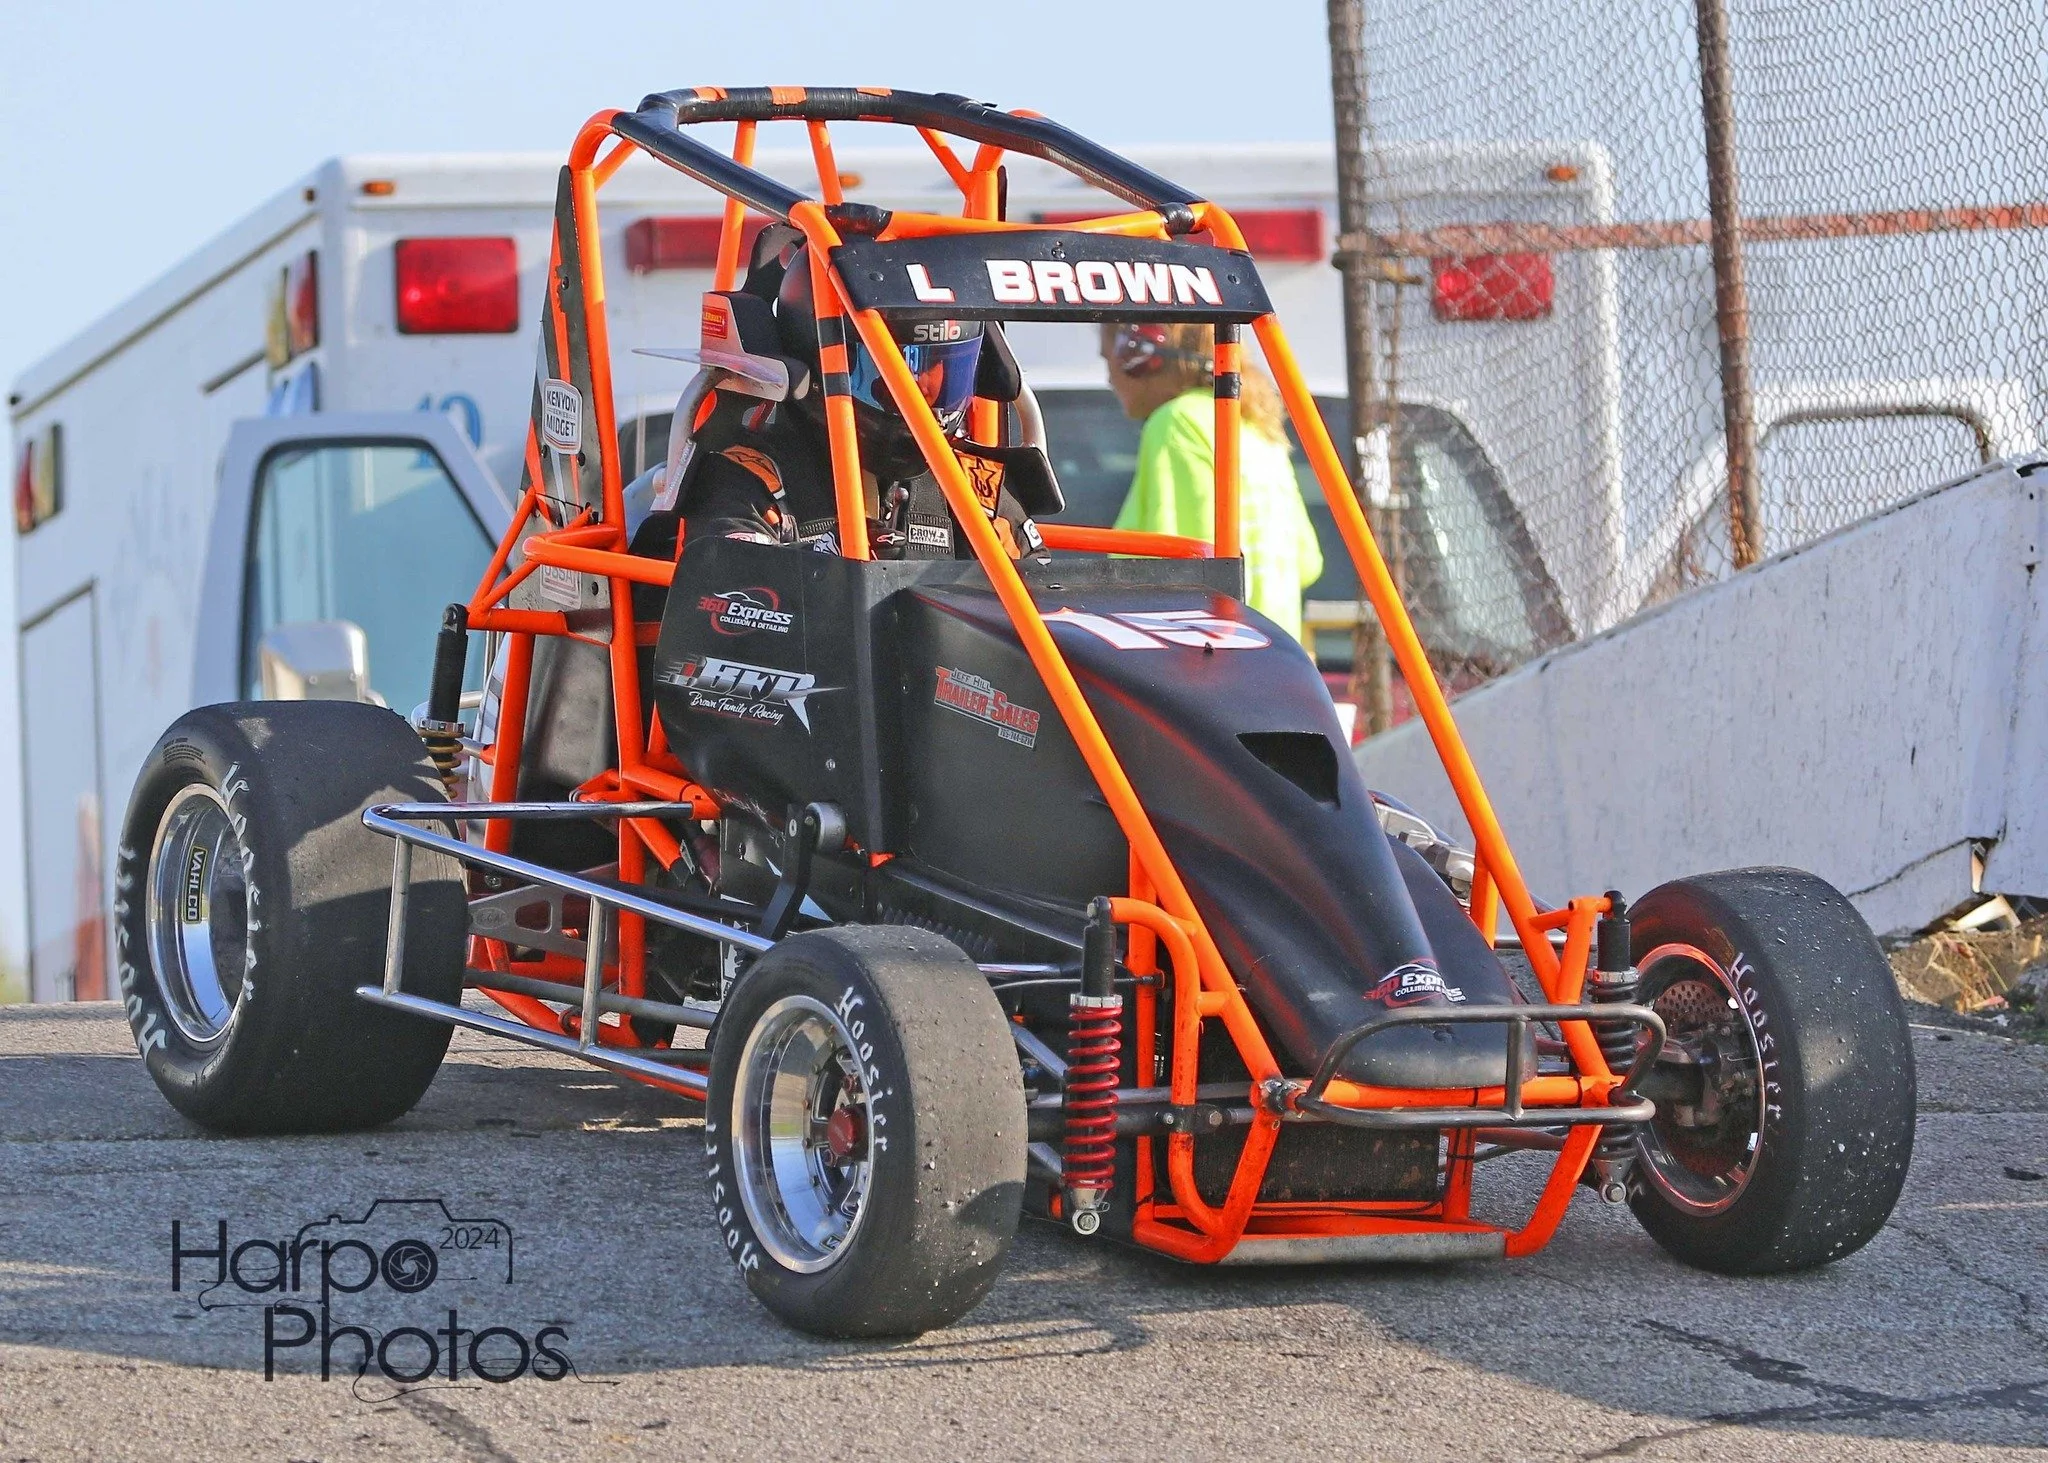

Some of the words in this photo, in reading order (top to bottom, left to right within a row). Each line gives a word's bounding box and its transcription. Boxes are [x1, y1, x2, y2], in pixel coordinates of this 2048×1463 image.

[904, 263, 955, 302] L
[985, 259, 1223, 305] BROWN
[546, 390, 577, 413] KENYON
[546, 414, 576, 437] MIDGET
[910, 527, 937, 539] CROW
[697, 596, 728, 614] 360
[727, 602, 794, 625] Express
[719, 615, 751, 627] COLLISION
[757, 622, 789, 634] DETAILING
[1040, 606, 1272, 651] 15
[935, 666, 989, 717] TRAILER
[991, 690, 1040, 734] SALES
[951, 669, 969, 683] JEFF
[972, 675, 991, 692] HILL
[688, 691, 717, 708] Brown
[718, 697, 748, 718] Family
[749, 703, 784, 726] Racing
[186, 850, 205, 921] VAHLCO
[1725, 951, 1782, 1120] Hoosier
[833, 986, 893, 1152] Hoosier
[705, 1121, 760, 1283] Hoosier
